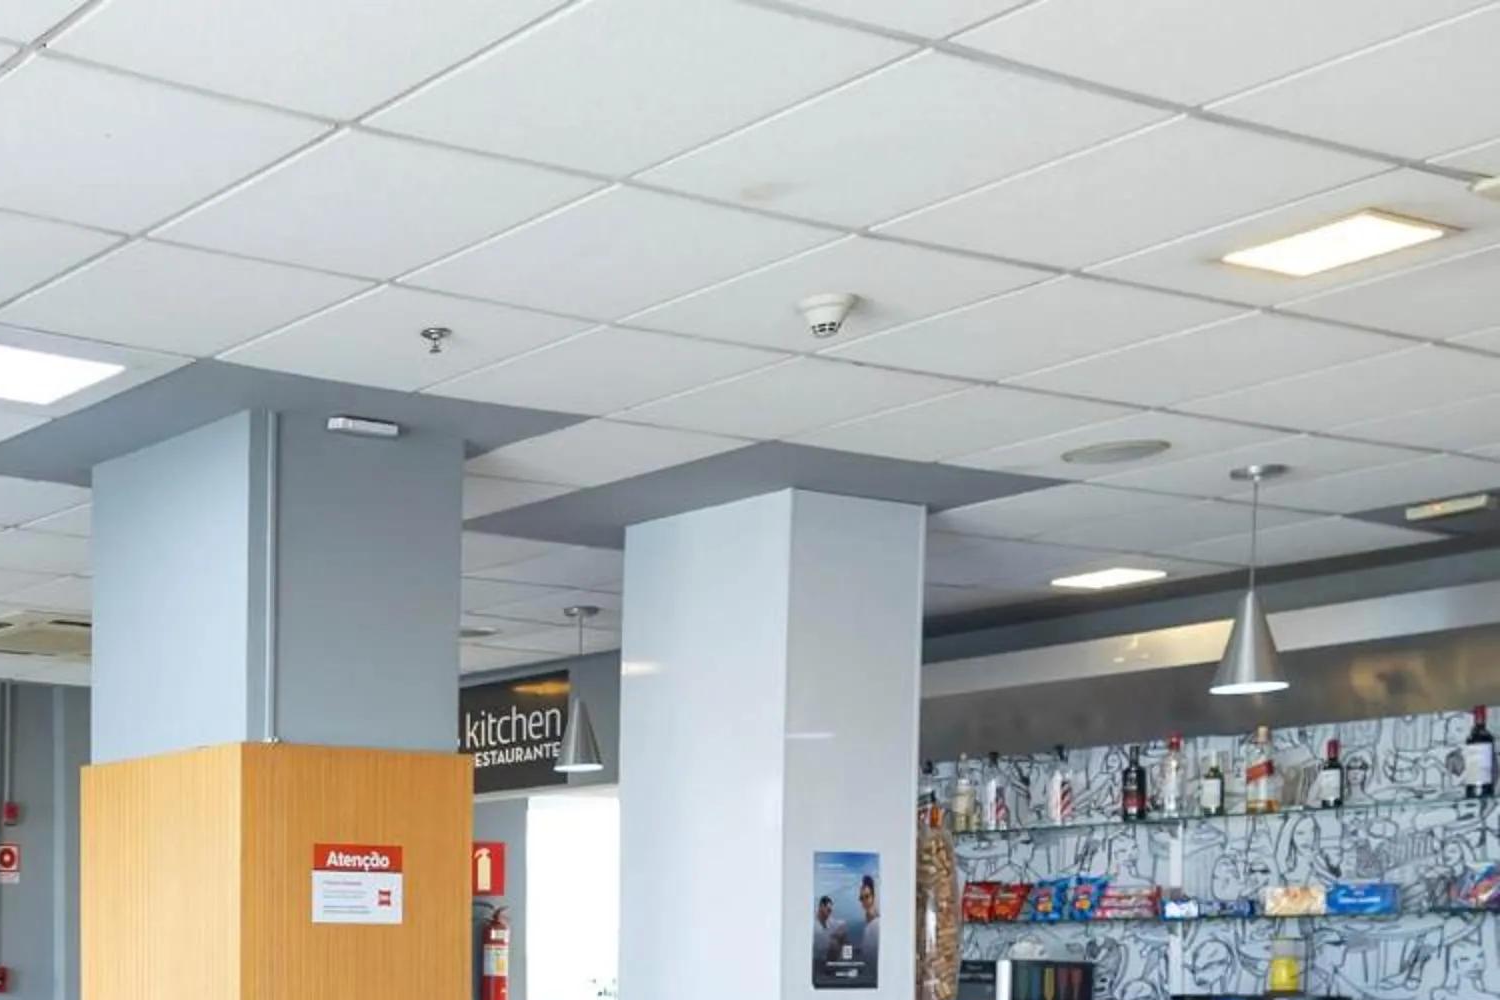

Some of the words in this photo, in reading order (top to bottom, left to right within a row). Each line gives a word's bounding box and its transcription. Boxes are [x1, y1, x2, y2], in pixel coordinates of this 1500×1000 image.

[465, 705, 561, 749] kitchen
[474, 741, 561, 769] ESTAURANTE
[325, 850, 391, 871] Atenção
